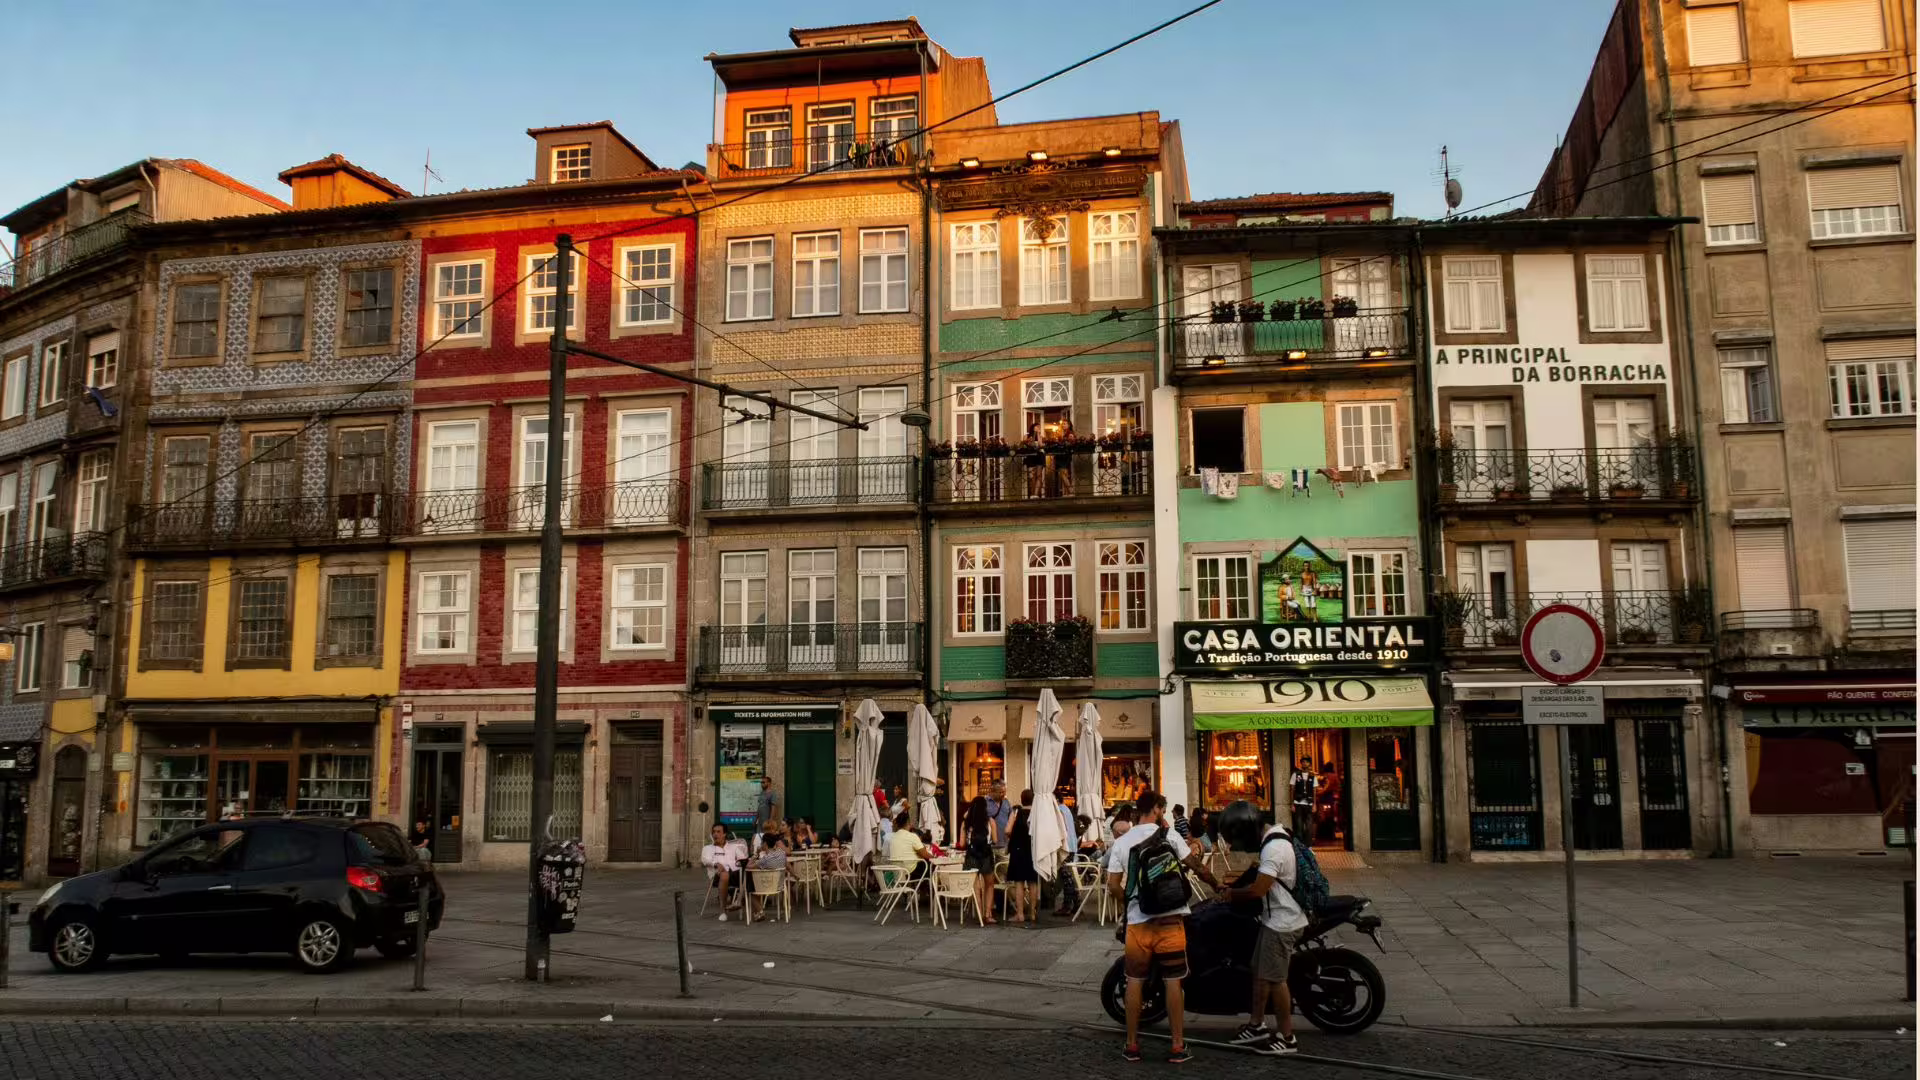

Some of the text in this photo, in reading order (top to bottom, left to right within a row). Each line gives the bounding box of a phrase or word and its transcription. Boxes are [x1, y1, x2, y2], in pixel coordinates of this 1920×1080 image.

[1436, 347, 1571, 365] A PRINCIPAL
[1512, 364, 1667, 383] DA BORRACHA
[1183, 625, 1425, 651] CASA ORIENTAL
[1195, 649, 1409, 665] A Tradição Portuguesa desde 1910
[1255, 679, 1377, 707] 1910
[1846, 691, 1877, 699] QUENTE
[1248, 713, 1391, 725] A CONSERVEIRA DO PORTO
[1769, 704, 1916, 723] Muralh
